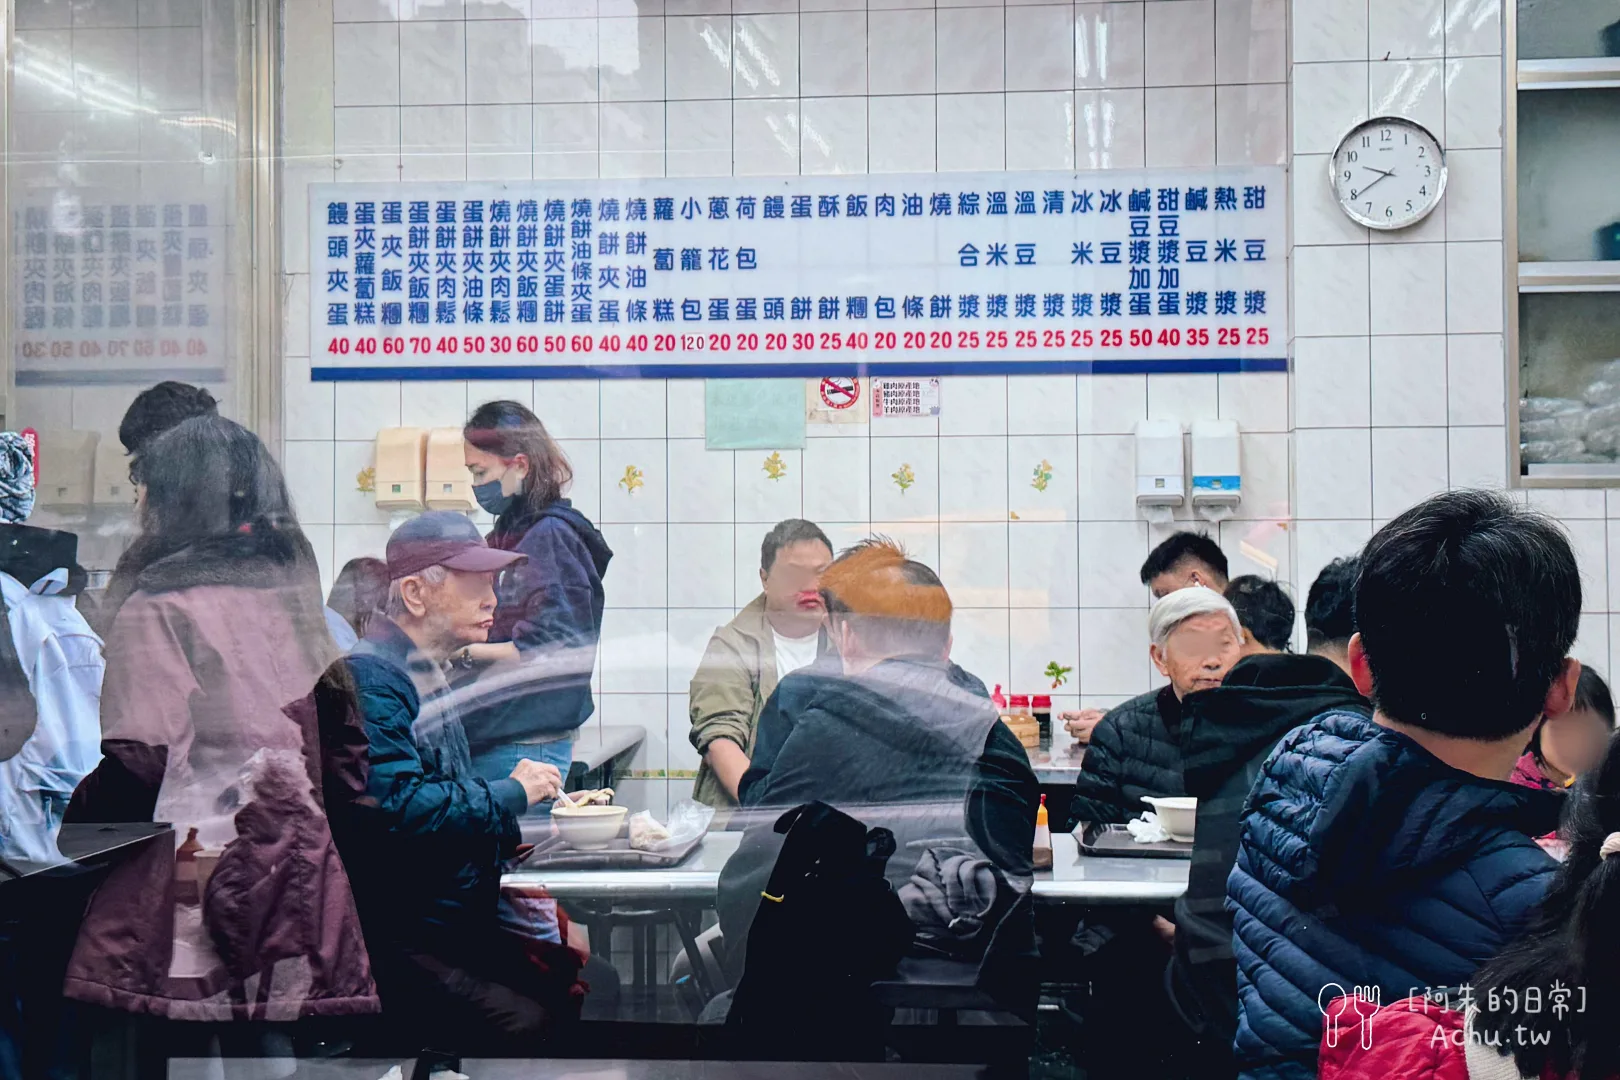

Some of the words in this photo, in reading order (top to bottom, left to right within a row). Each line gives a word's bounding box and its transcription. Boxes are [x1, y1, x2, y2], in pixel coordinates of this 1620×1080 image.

[1380, 129, 1392, 141] 12
[1404, 134, 1408, 145] 1
[1362, 136, 1370, 148] 11
[1347, 151, 1358, 162] 10
[1418, 146, 1424, 158] 2
[1344, 170, 1351, 182] 9
[1424, 166, 1431, 177] 3
[1350, 189, 1358, 200] 8
[1418, 185, 1426, 196] 4
[1366, 202, 1372, 213] 7
[1405, 200, 1412, 211] 5
[1385, 206, 1392, 217] 6
[327, 337, 350, 355] 40
[354, 337, 377, 355] 40
[382, 336, 405, 355] 60
[409, 336, 432, 354] 70
[435, 336, 459, 354] 40
[463, 335, 486, 354] 50
[489, 335, 512, 354] 30
[516, 335, 539, 353] 60
[544, 335, 567, 353] 50
[571, 334, 594, 353] 60
[598, 334, 621, 353] 40
[625, 334, 649, 352] 40
[653, 333, 677, 352] 20
[680, 334, 705, 351] 120
[708, 333, 732, 352] 20
[736, 332, 759, 351] 20
[765, 332, 788, 351] 20
[792, 332, 815, 351] 30
[819, 332, 842, 350] 25
[845, 332, 869, 350] 40
[874, 331, 897, 350] 20
[903, 331, 926, 349] 20
[929, 330, 953, 349] 20
[957, 330, 980, 349] 25
[985, 330, 1009, 349] 25
[1014, 330, 1038, 348] 25
[1042, 329, 1066, 348] 25
[1070, 329, 1094, 348] 25
[1100, 329, 1123, 347] 25
[1129, 328, 1153, 347] 50
[1156, 327, 1181, 347] 40
[1186, 327, 1210, 347] 35
[1217, 327, 1241, 346] 25
[1246, 327, 1270, 346] 25
